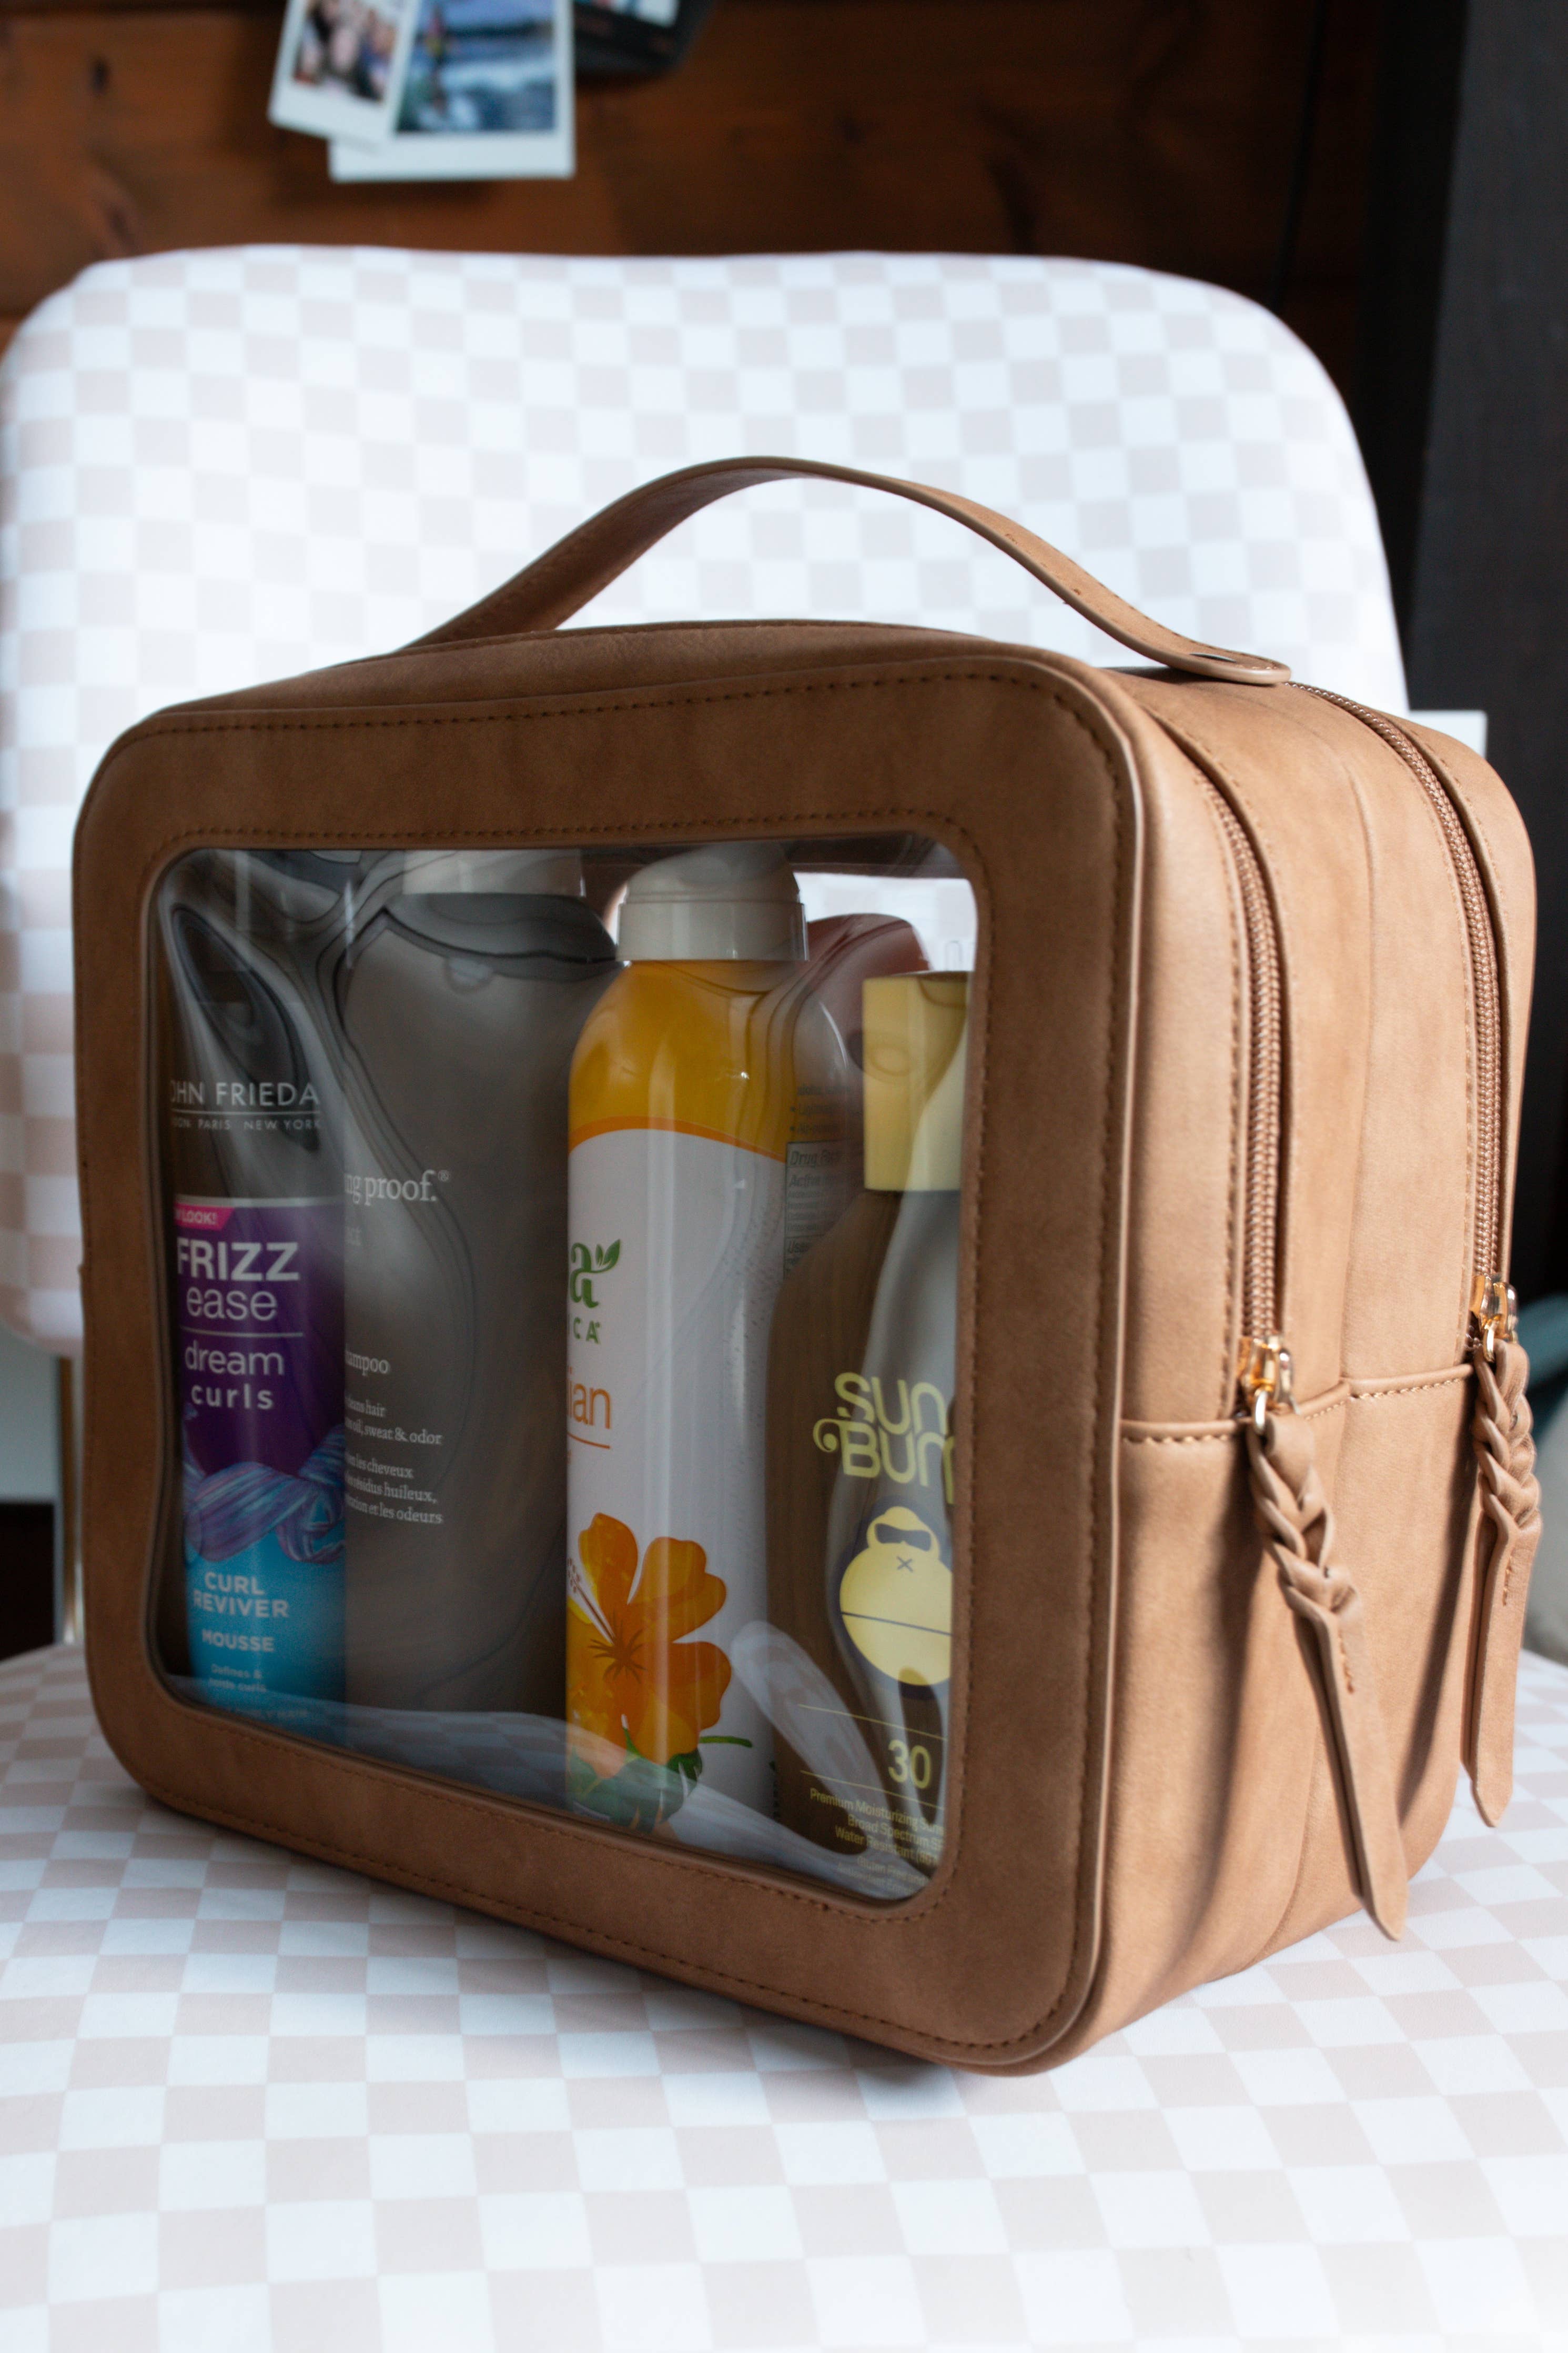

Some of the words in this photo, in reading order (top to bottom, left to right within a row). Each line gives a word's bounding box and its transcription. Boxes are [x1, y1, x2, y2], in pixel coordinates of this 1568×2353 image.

[216, 1082, 321, 1106] FRIEDA
[198, 1119, 230, 1130] PARIS
[244, 1119, 277, 1130] NEW
[284, 1119, 320, 1130] YORK
[177, 1237, 300, 1281] FRIZZ
[186, 1286, 278, 1321] ease
[185, 1340, 285, 1375] dream
[191, 1383, 274, 1410] curls
[366, 1399, 387, 1418] hair
[394, 1426, 408, 1442] &
[409, 1429, 443, 1445] odor
[367, 1457, 414, 1479] cheveux
[383, 1482, 437, 1504] huileux,
[379, 1502, 395, 1520] les
[396, 1507, 444, 1525] odeurs
[205, 1572, 266, 1595] CURL
[193, 1590, 289, 1618] REVIVER
[201, 1629, 275, 1652] MOUSSE
[888, 1738, 932, 1789] 30
[810, 1787, 854, 1810] Premium
[855, 1799, 918, 1832] Moisturizing
[834, 1826, 865, 1846] Water
[847, 1815, 879, 1835] Broad
[880, 1823, 928, 1848] Spectrum
